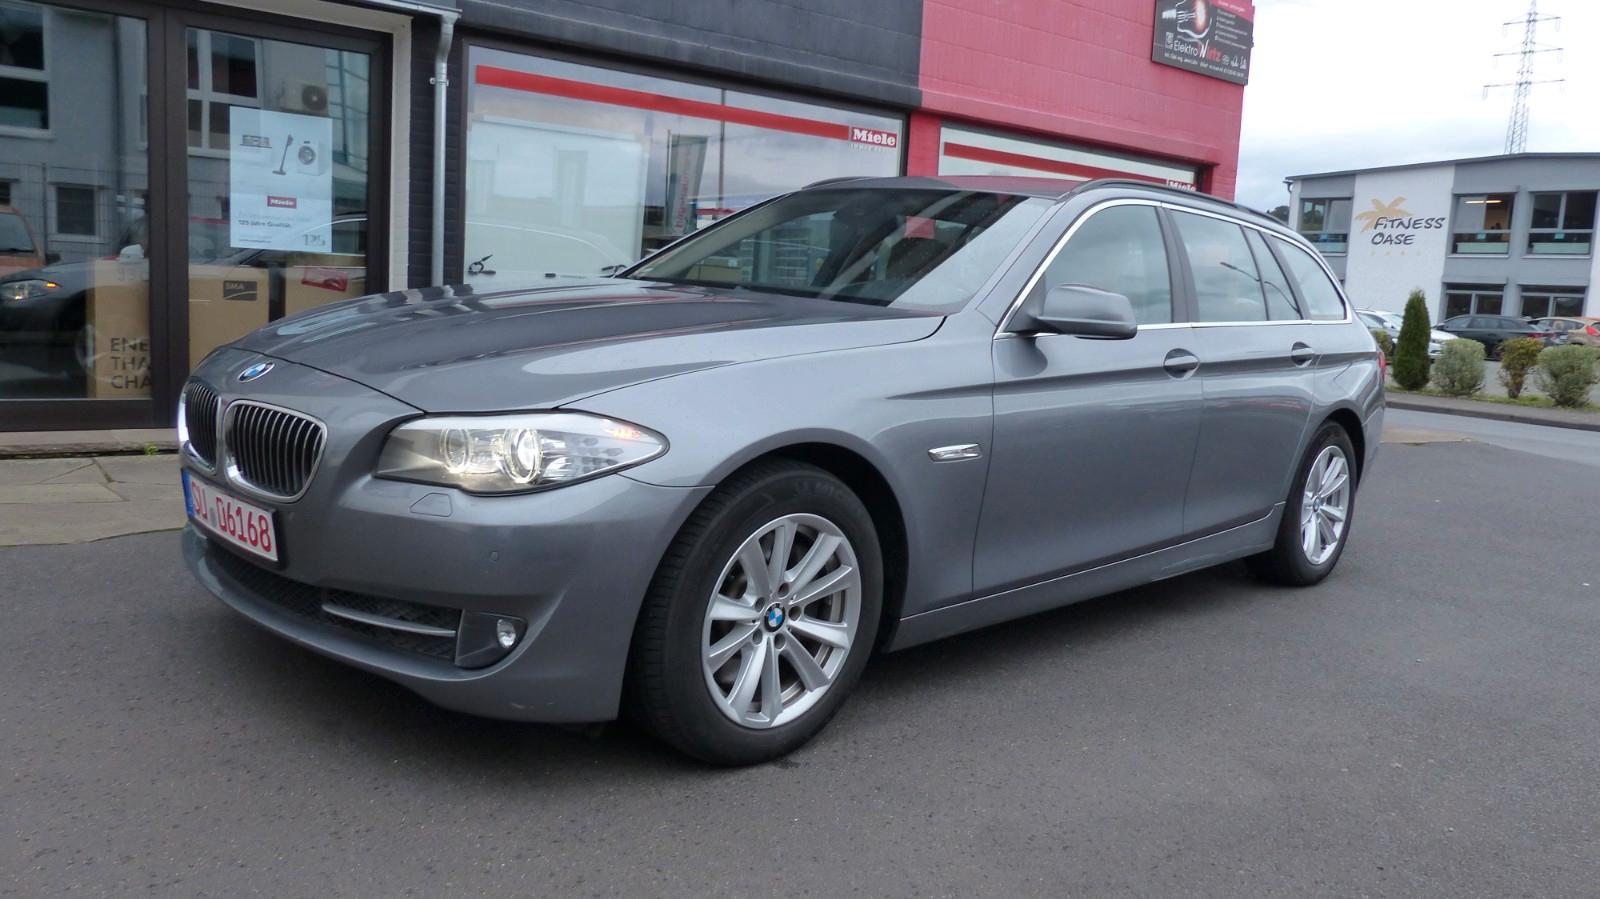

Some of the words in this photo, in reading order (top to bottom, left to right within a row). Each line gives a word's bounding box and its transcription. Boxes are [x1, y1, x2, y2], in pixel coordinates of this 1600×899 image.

[1174, 40, 1199, 57] Elektro
[853, 128, 896, 146] Miele
[225, 281, 245, 290] SMA
[192, 480, 208, 520] SU
